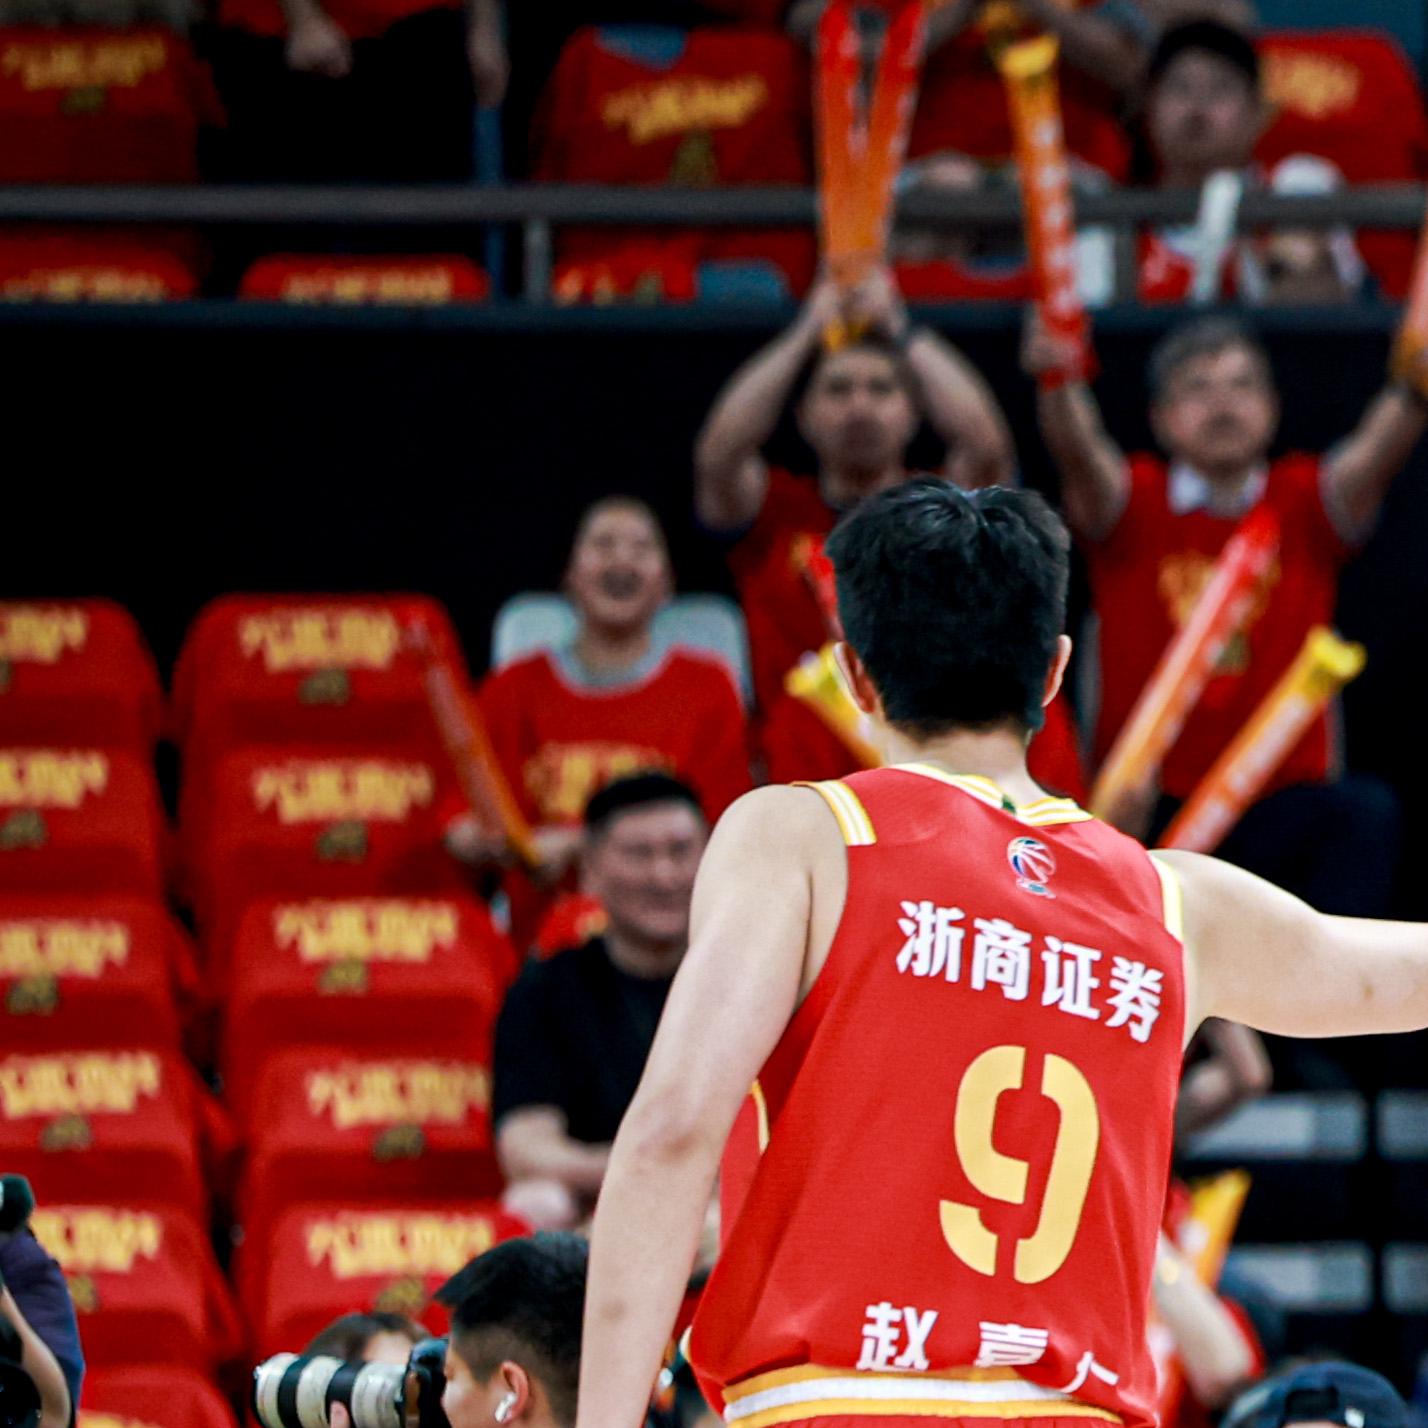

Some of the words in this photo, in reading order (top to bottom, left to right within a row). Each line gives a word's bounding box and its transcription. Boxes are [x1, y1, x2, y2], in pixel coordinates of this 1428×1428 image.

[896, 900, 1164, 1043] 浙商证券
[940, 1045, 1100, 1284] 9
